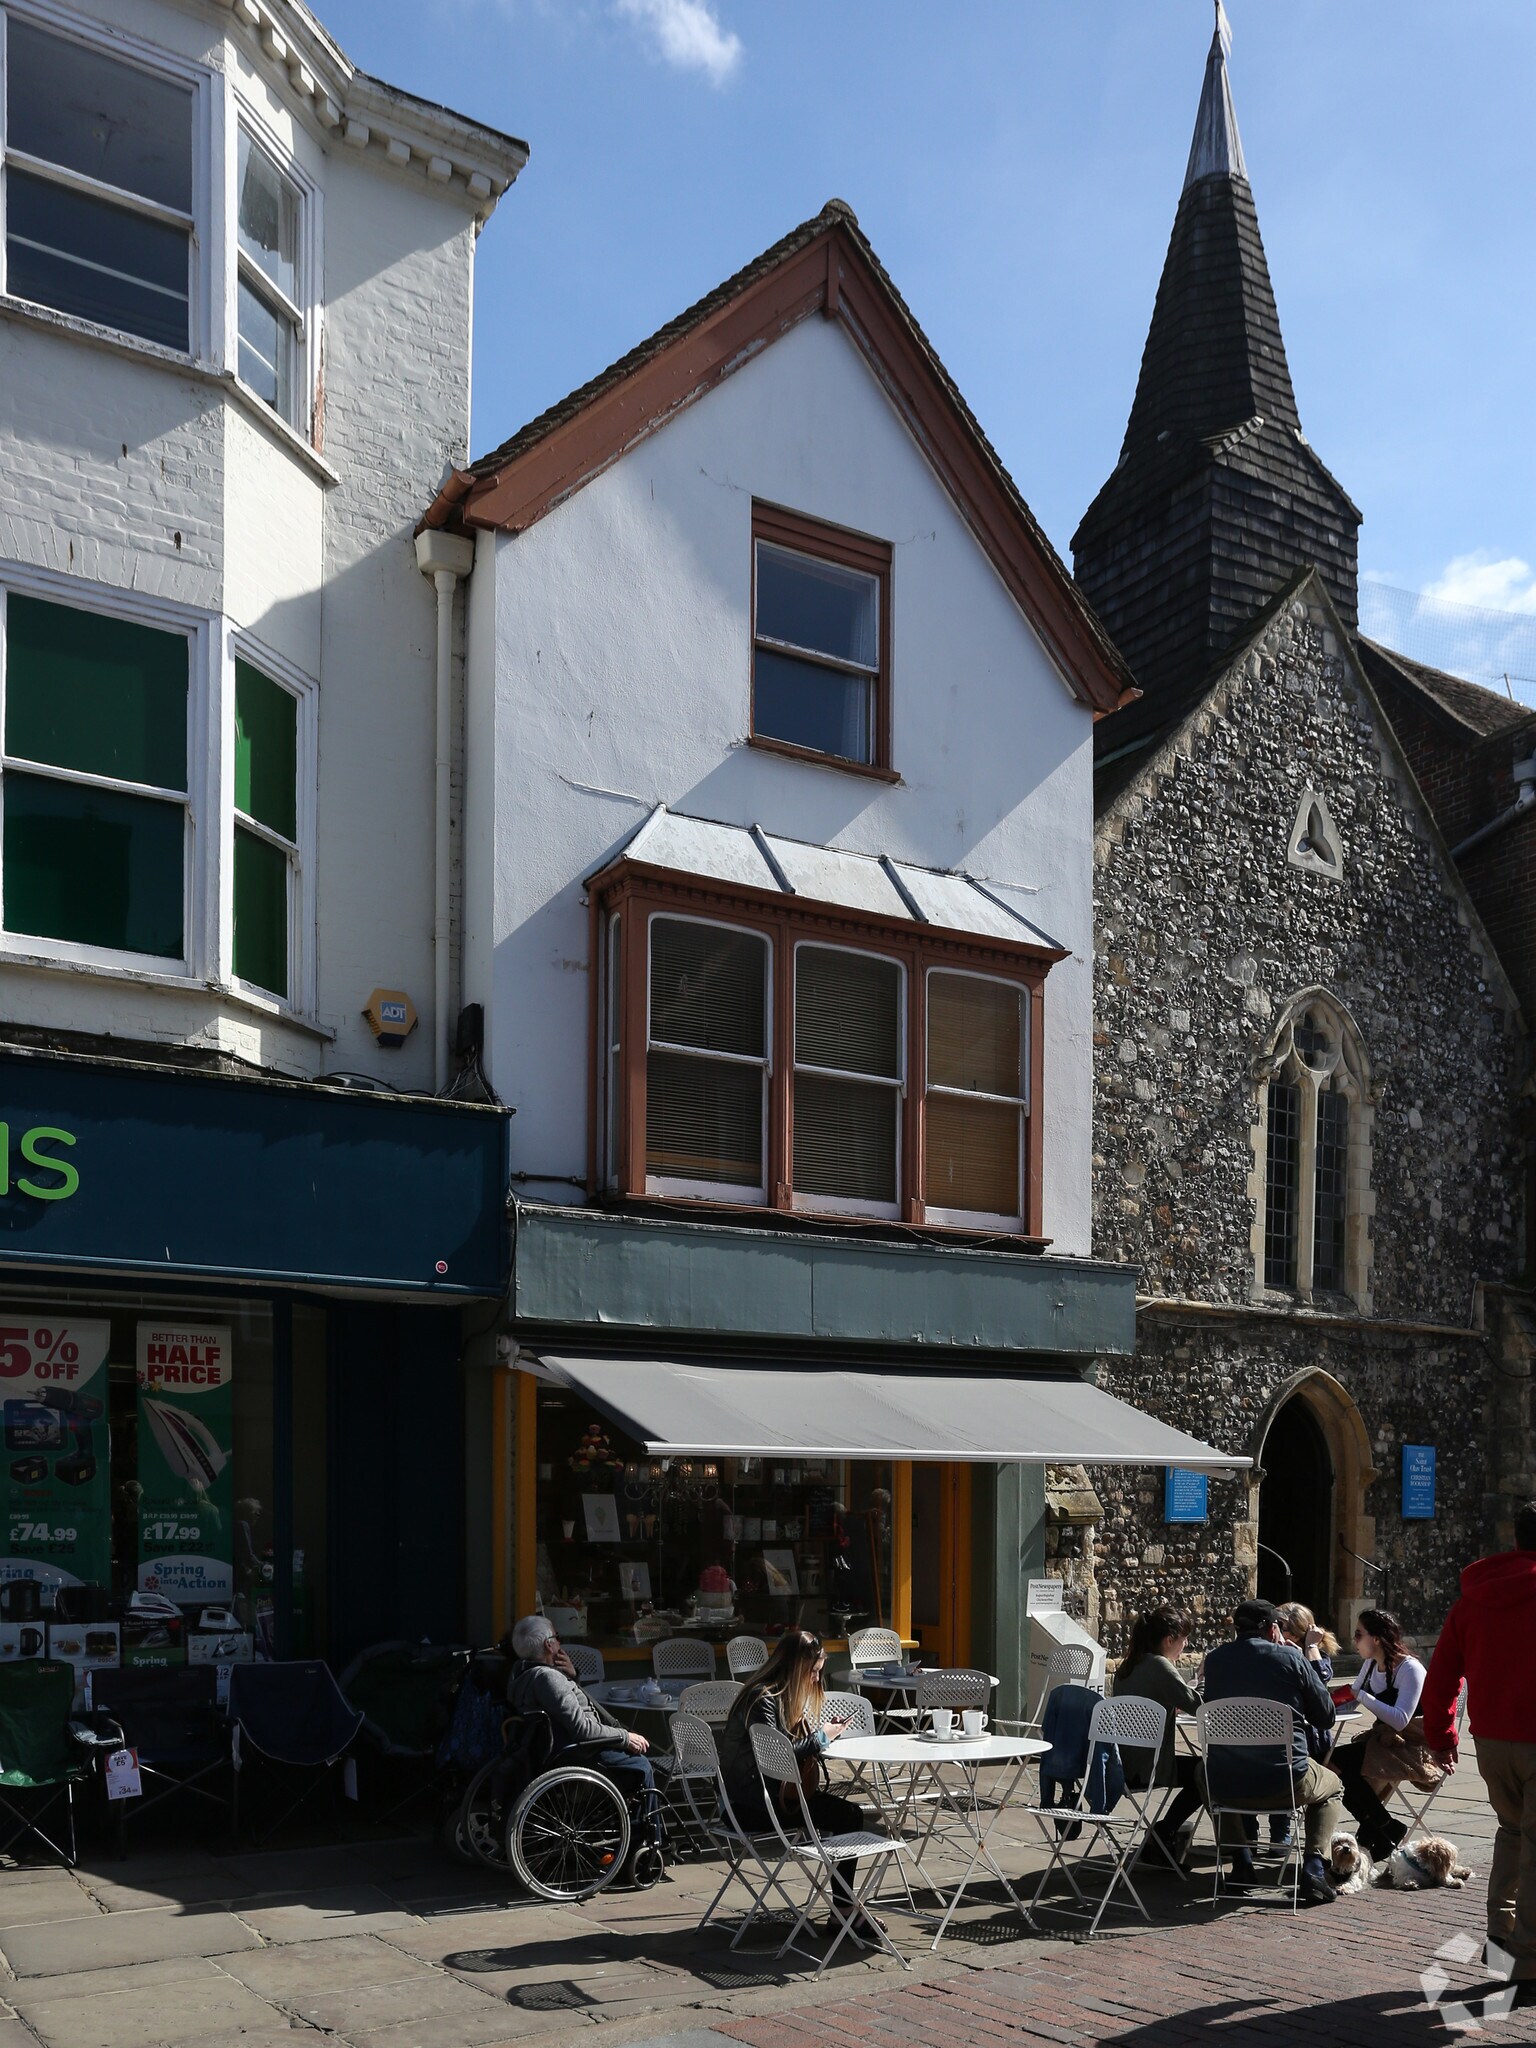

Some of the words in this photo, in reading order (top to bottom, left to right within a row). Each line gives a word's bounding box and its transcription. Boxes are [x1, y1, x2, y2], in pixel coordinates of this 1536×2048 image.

[382, 1006, 406, 1018] ADT
[151, 1333, 188, 1343] BETTER
[190, 1335, 216, 1344] THAN
[147, 1343, 221, 1366] HALF
[34, 1362, 79, 1380] OFF
[147, 1364, 221, 1385] PRICE
[9, 1522, 77, 1541] £74.99
[143, 1522, 200, 1540] £17.99
[10, 1543, 43, 1554] Save
[48, 1543, 75, 1554] £25
[143, 1542, 175, 1553] Save
[154, 1562, 204, 1578] Spring
[160, 1577, 178, 1585] into
[177, 1576, 226, 1588] Action
[132, 1655, 168, 1668] Spring
